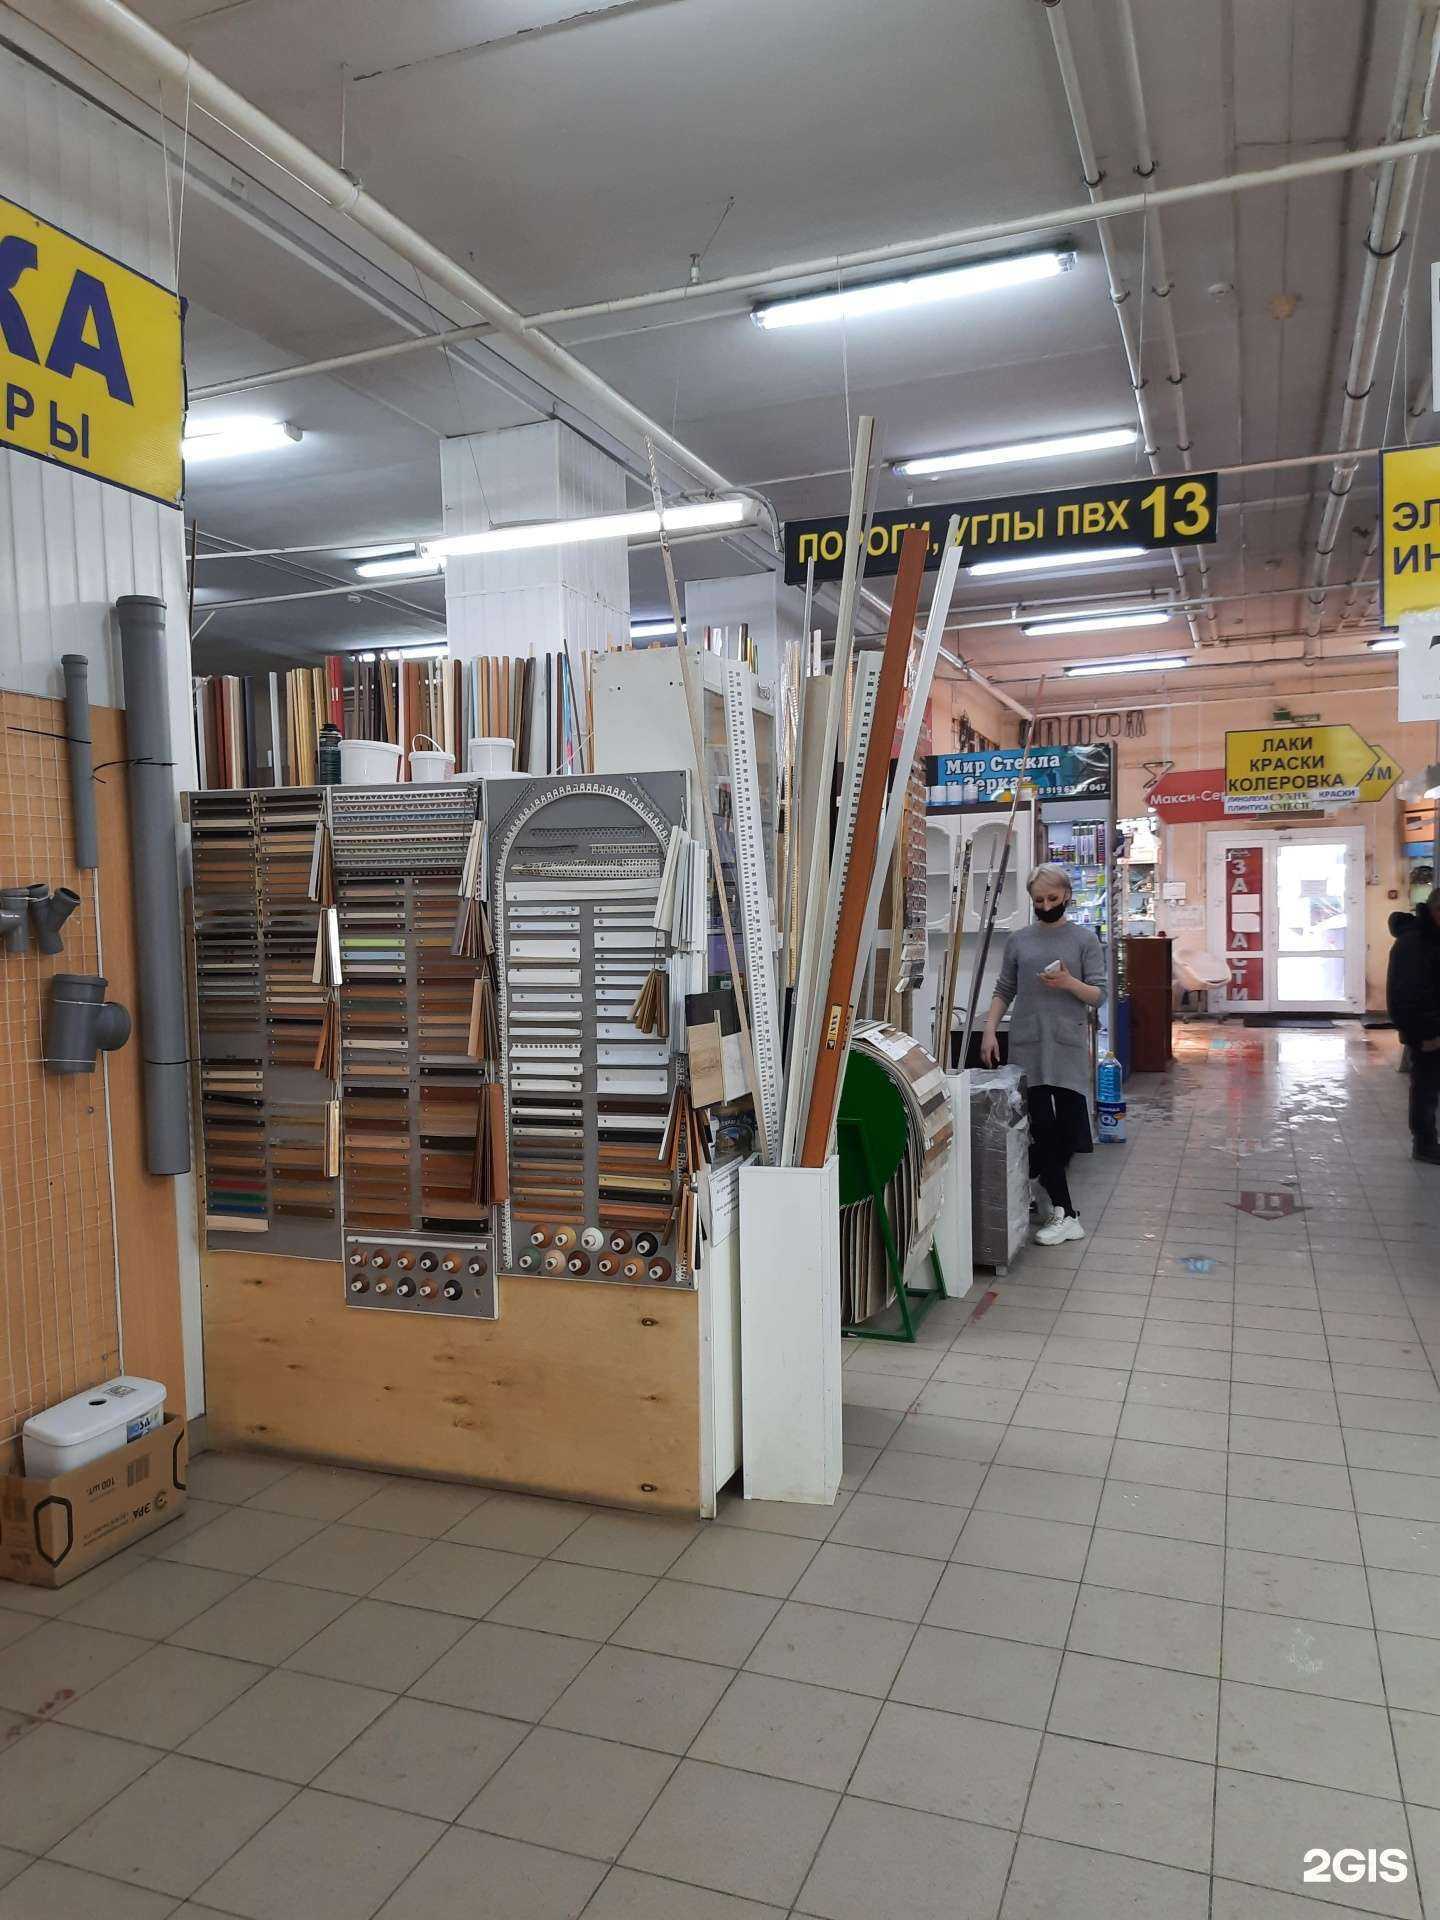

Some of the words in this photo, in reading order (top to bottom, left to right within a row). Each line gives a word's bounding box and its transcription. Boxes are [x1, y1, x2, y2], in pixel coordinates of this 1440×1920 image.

[1056, 499, 1131, 537] ПВХ
[1140, 482, 1210, 539] 13
[1262, 736, 1313, 753] ЛАКИ
[945, 759, 986, 777] Мир
[990, 755, 1060, 772] Стекла
[1250, 755, 1325, 772] КРАСКИ
[1228, 773, 1345, 792] КОЛЕРОВКА
[1318, 789, 1356, 798] КРАСКИ
